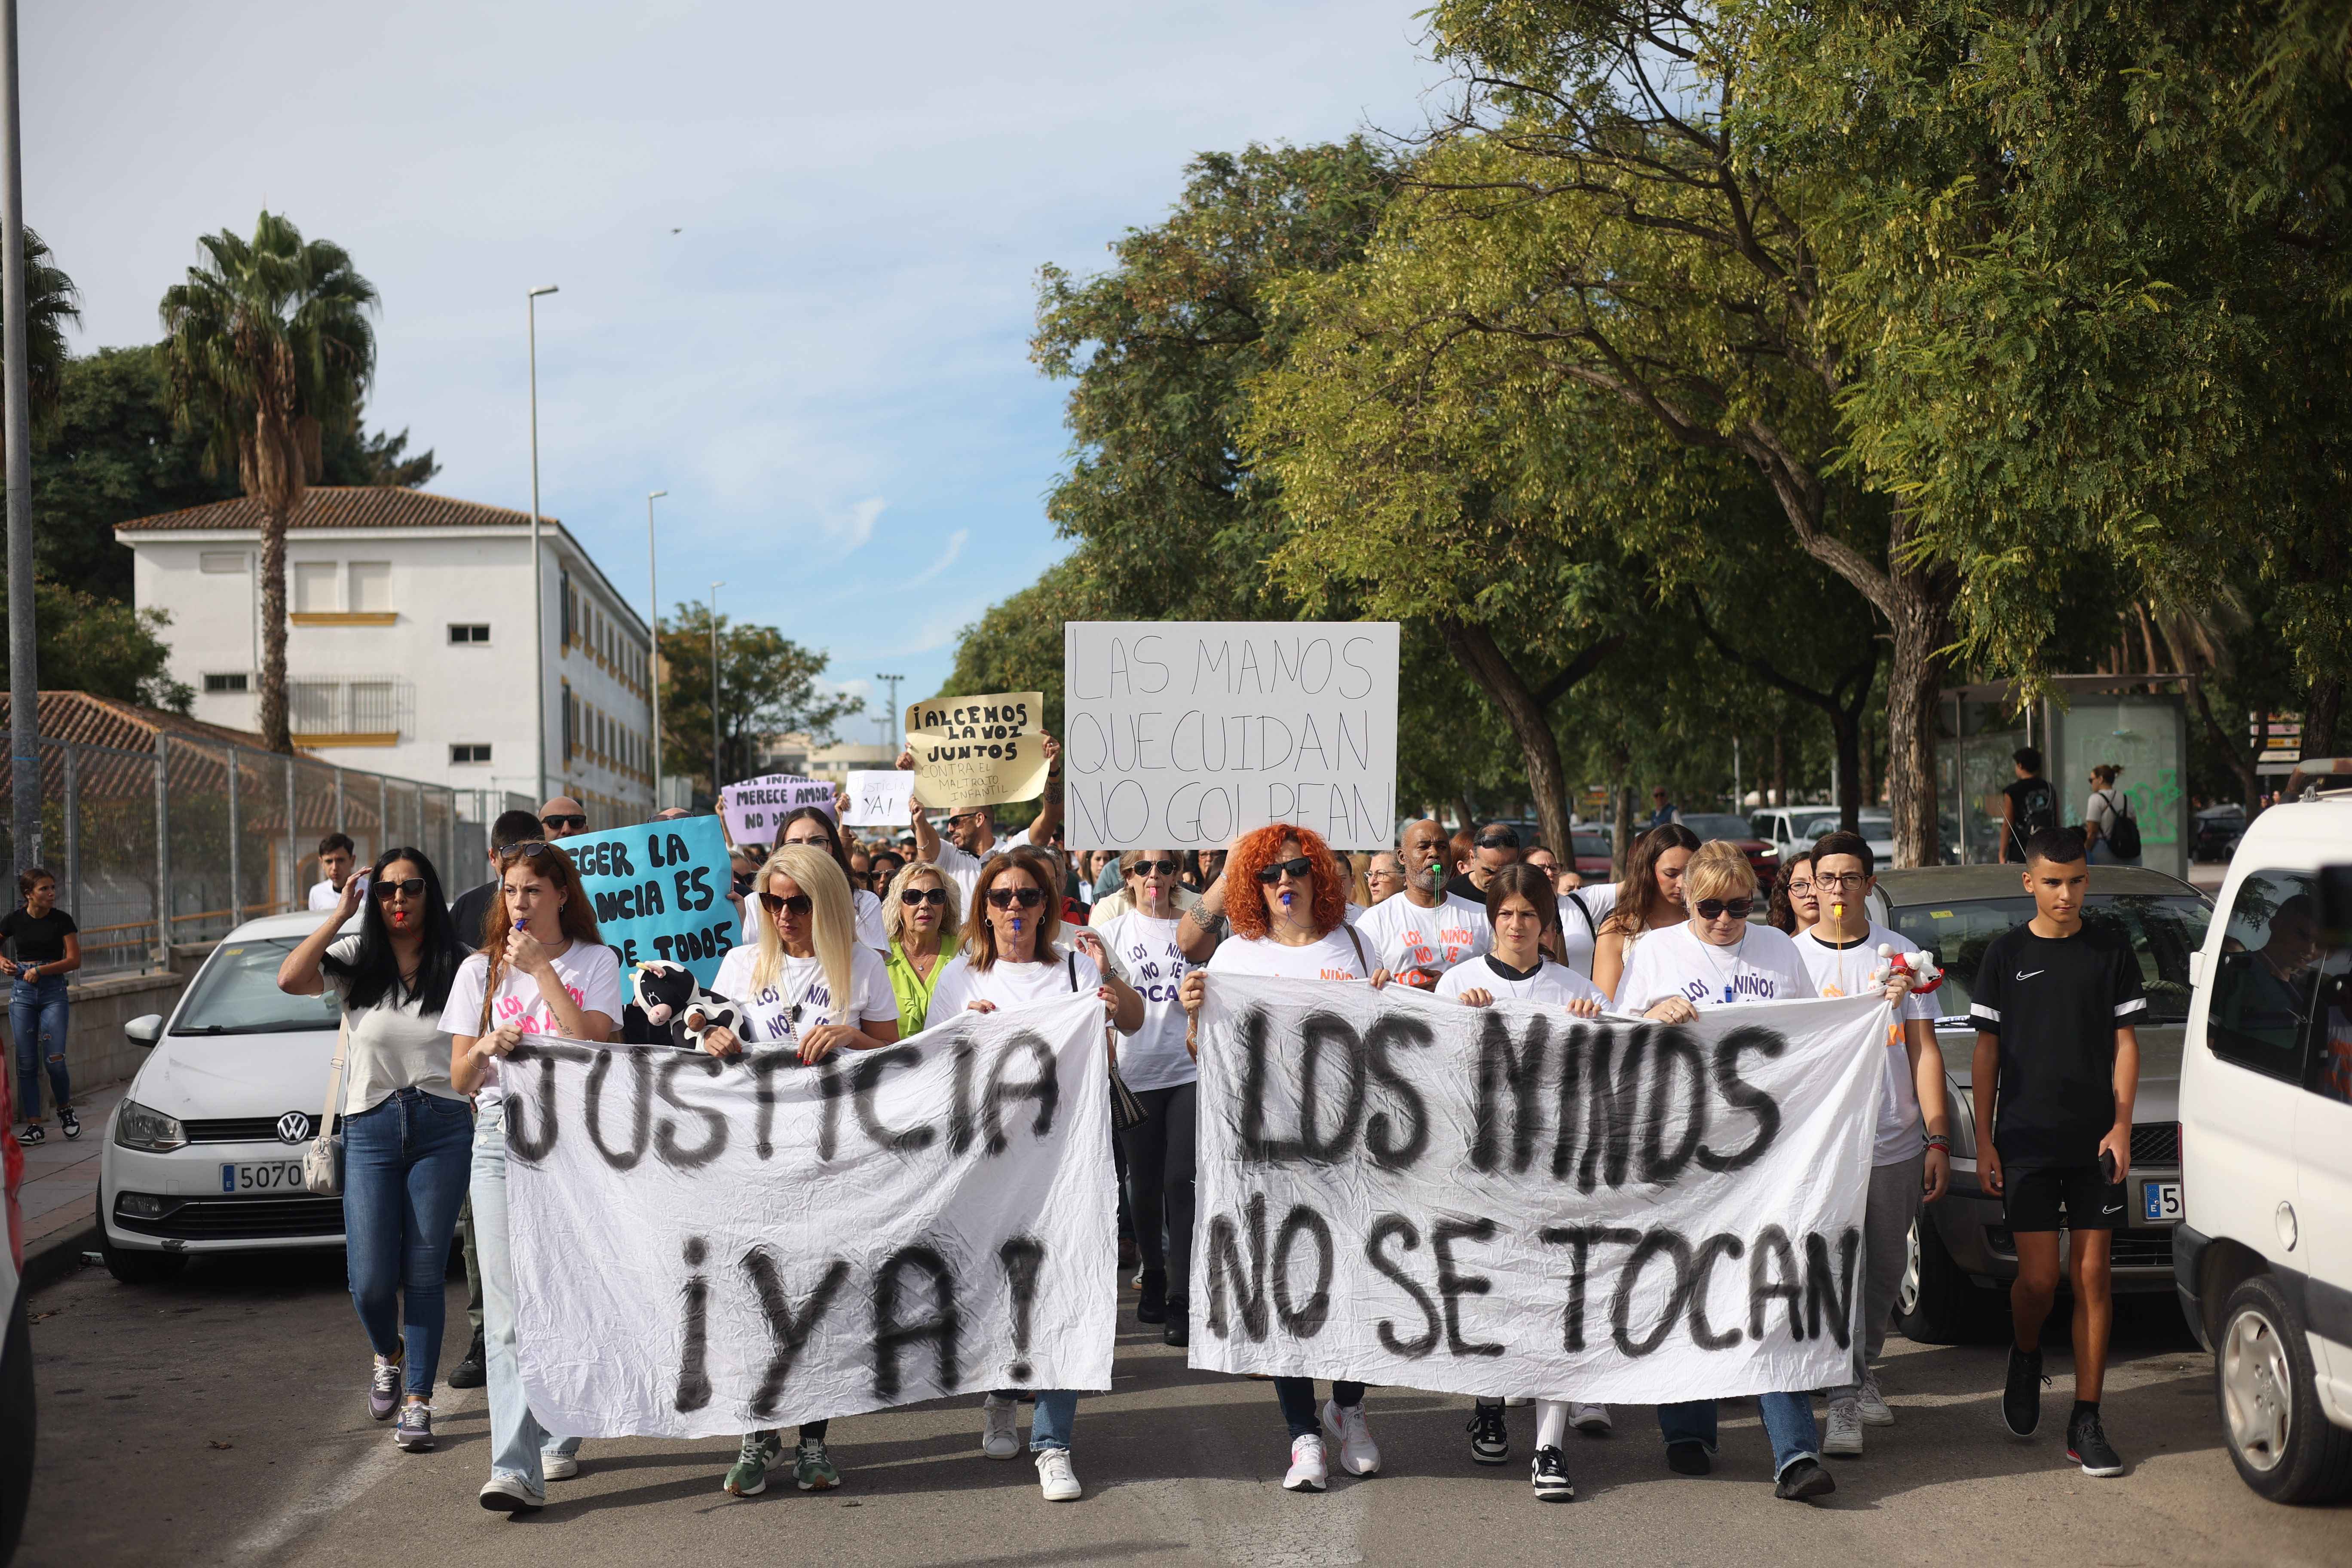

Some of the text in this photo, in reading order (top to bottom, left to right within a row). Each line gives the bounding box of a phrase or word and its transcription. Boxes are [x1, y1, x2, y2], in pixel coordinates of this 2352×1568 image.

[1074, 629, 1373, 699] LAS MANOS
[948, 725, 1023, 740] LA VOZ
[1070, 710, 1368, 774] QUE CUIDAN
[928, 742, 1017, 763] JUNTOS
[922, 763, 991, 778] CONTRA EL
[737, 787, 832, 806] MERECE AMOR,
[745, 811, 790, 829] NO DO
[1071, 779, 1149, 846] NO
[649, 833, 689, 868] LA
[592, 867, 714, 924] NCIA ES
[653, 921, 732, 962] TODOS
[1402, 926, 1473, 947] LOS NIÑOS
[1127, 943, 1147, 963] LOS
[1414, 946, 1459, 965] NO SE
[1140, 962, 1183, 981] NO SE
[1320, 967, 1358, 980] NIÑO
[754, 984, 780, 1007] LOS
[1681, 973, 1774, 1002] LOS NIÑOS
[496, 995, 524, 1020] LOS
[766, 1014, 790, 1039] NO
[1237, 1002, 1436, 1171] LOS
[503, 1030, 1060, 1169] JUSTICIA
[241, 1165, 301, 1188] 5070
[2163, 1188, 2179, 1213] 5
[1205, 1189, 1862, 1360] NO SE TOCAN
